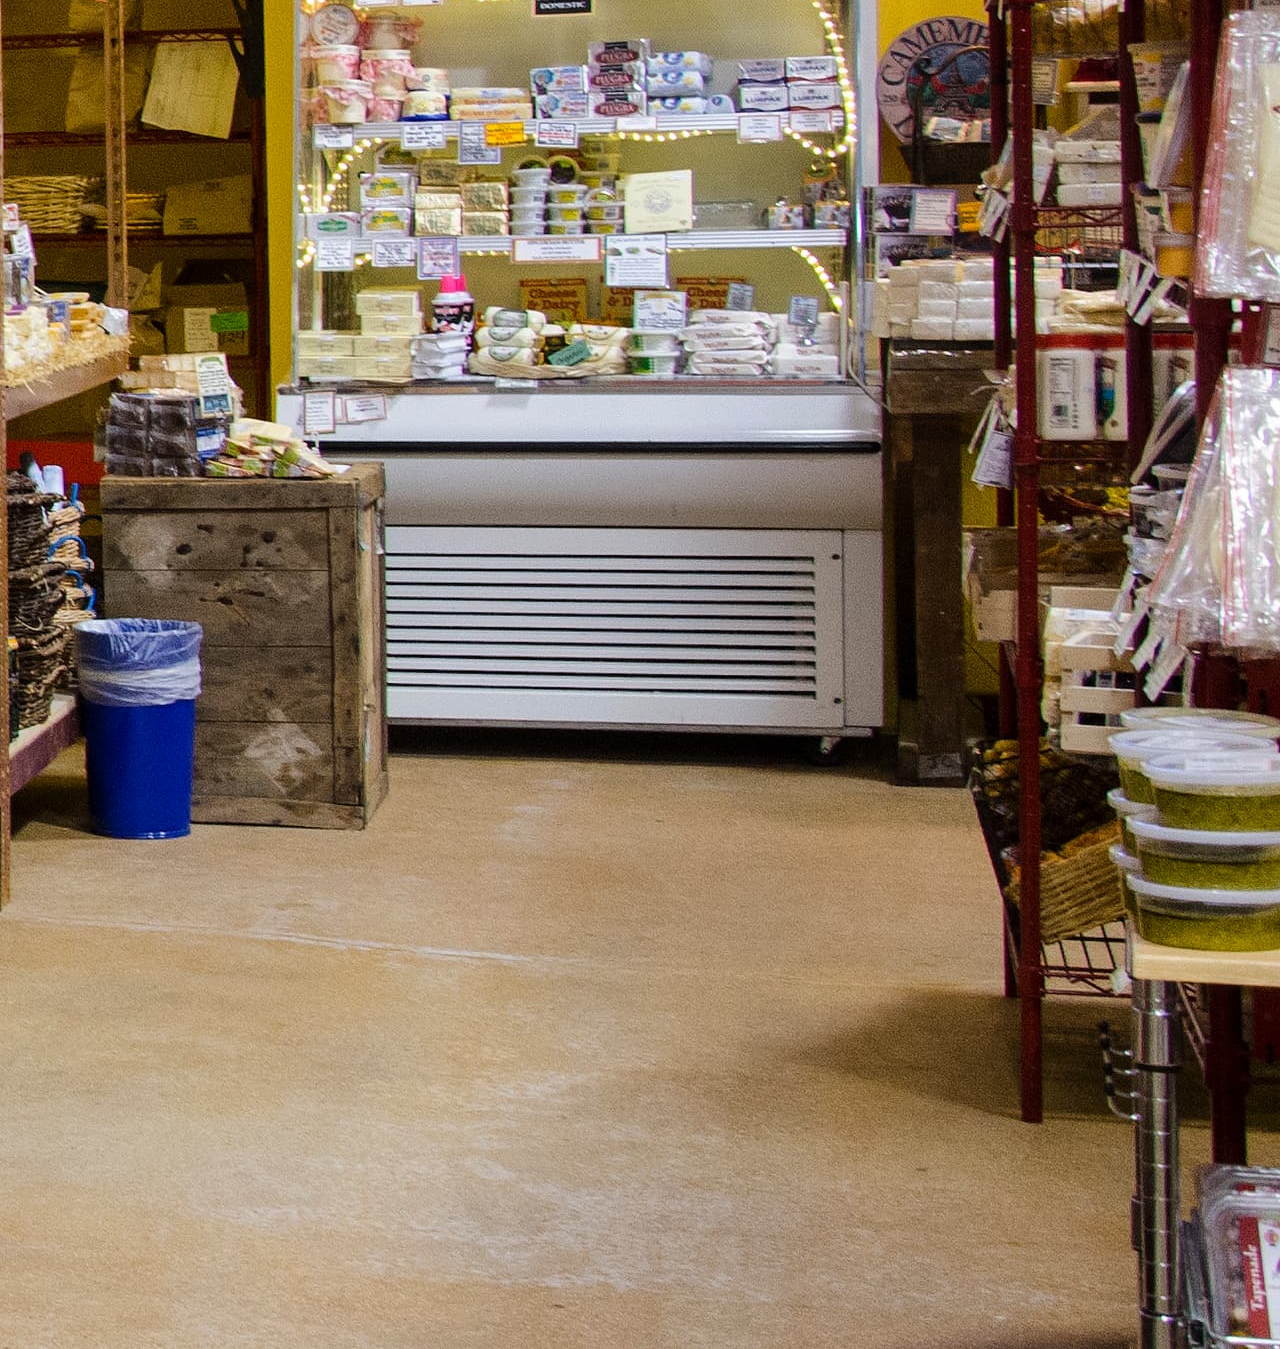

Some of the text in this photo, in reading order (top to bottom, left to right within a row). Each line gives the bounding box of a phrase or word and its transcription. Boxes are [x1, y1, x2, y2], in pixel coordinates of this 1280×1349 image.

[540, 1, 586, 10] DOMESTIC
[881, 17, 990, 86] CAMEMB
[529, 288, 577, 299] Cheese
[687, 287, 727, 298] Chees
[542, 299, 580, 310] Dairy
[1243, 1244, 1267, 1311] Tapenade
